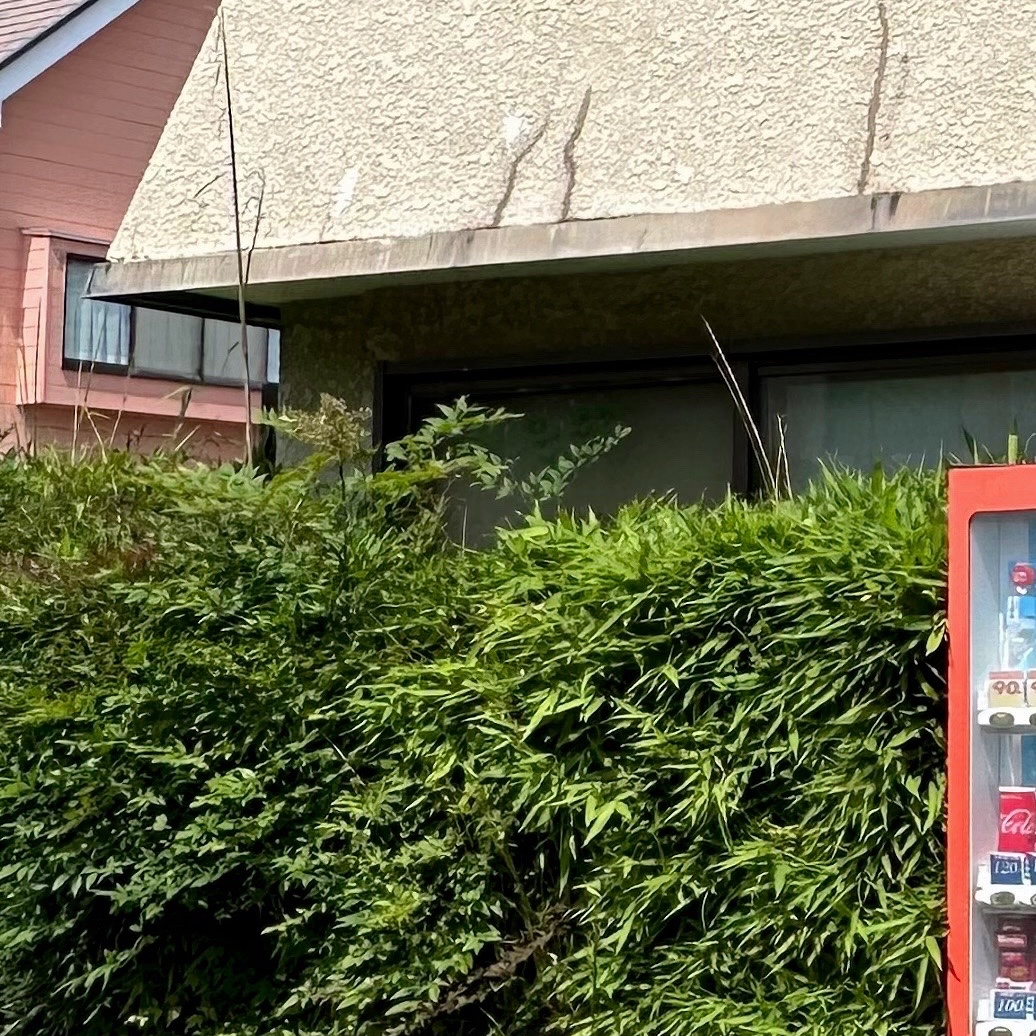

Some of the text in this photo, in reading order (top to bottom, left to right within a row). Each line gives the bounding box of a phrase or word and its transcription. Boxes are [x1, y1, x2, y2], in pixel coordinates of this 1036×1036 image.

[993, 680, 1020, 695] 90
[995, 861, 1018, 874] 120
[998, 999, 1024, 1013] 100
